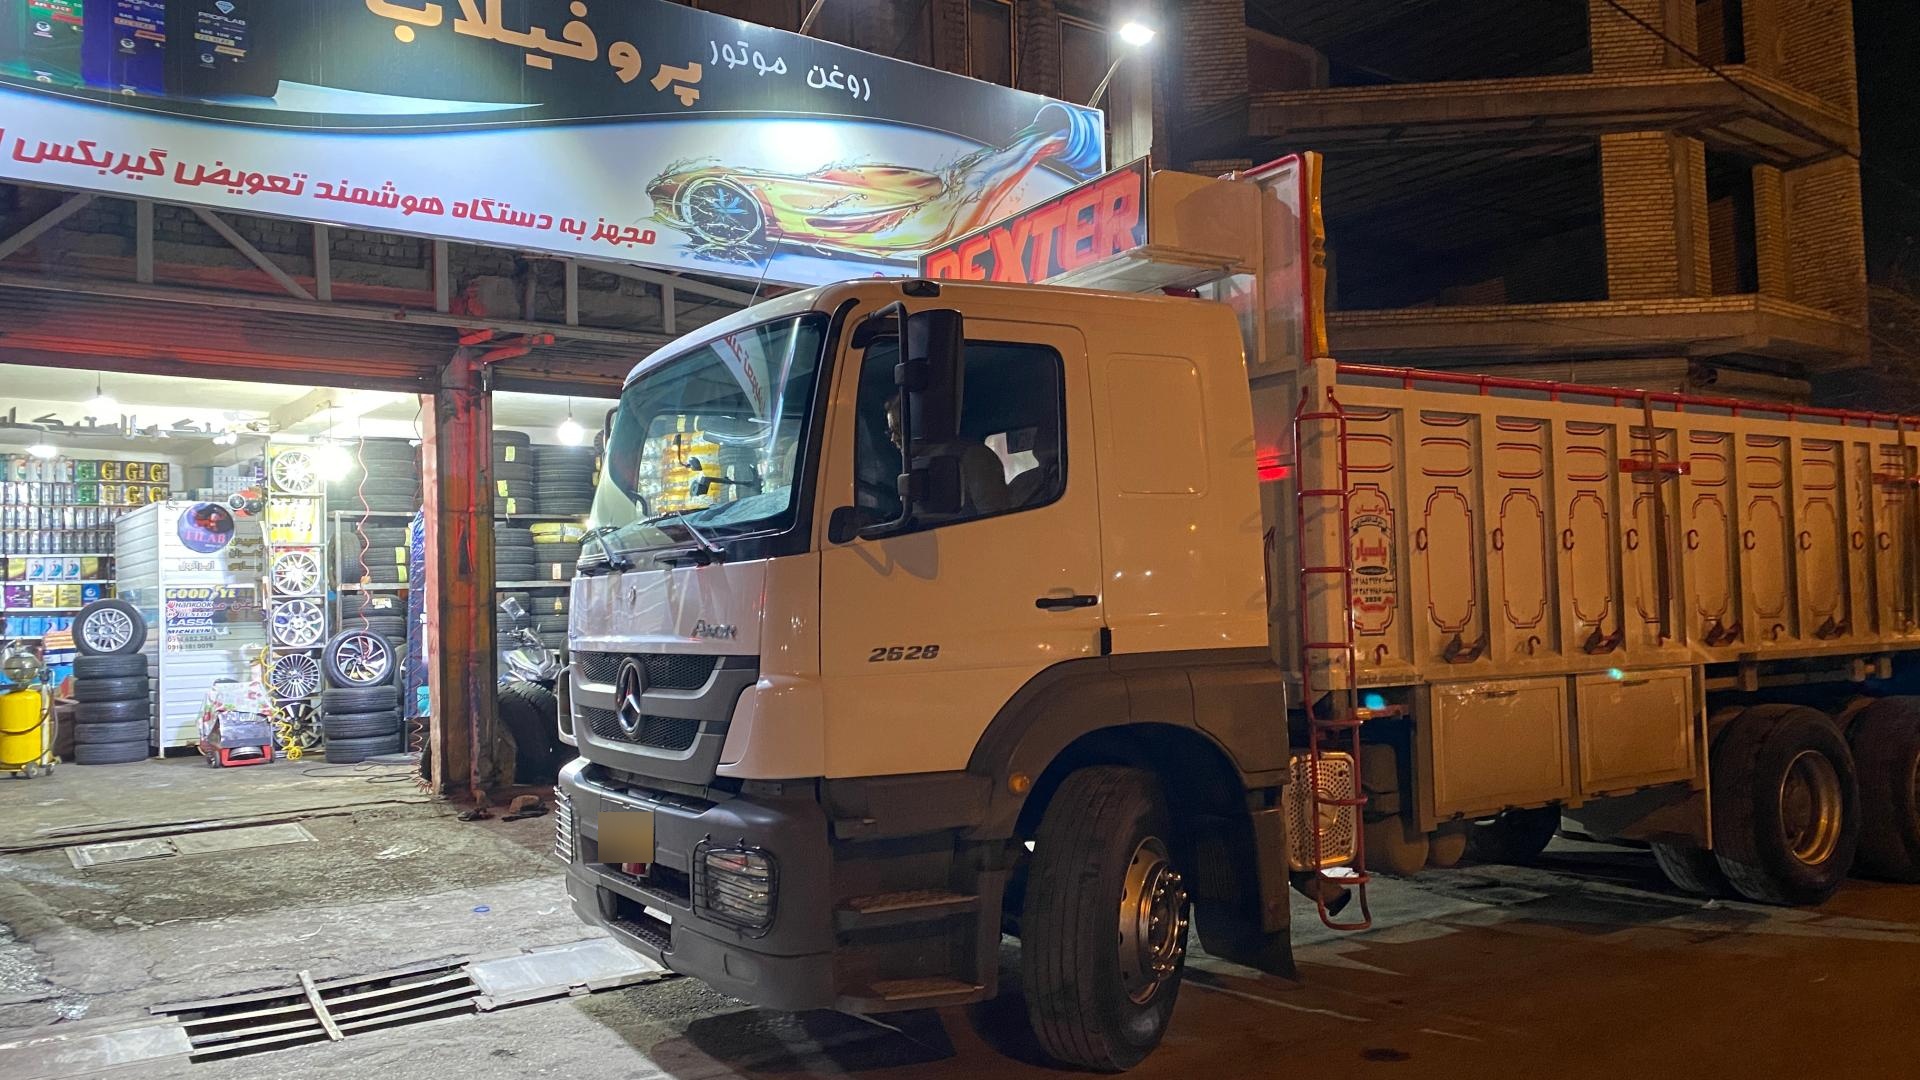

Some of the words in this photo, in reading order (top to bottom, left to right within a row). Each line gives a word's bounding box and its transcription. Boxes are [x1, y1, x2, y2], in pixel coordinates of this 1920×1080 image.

[710, 40, 788, 77] موتور
[807, 64, 871, 102] روغن
[12, 137, 168, 181] گیربکس
[174, 161, 307, 196] تعویض
[313, 180, 445, 216] هوشمند
[452, 197, 553, 231] دستگاه
[559, 214, 587, 241] به
[591, 217, 657, 248] مجهز
[926, 168, 1141, 284] DEXTER
[168, 618, 213, 626] LASSA
[868, 644, 939, 662] 2628
